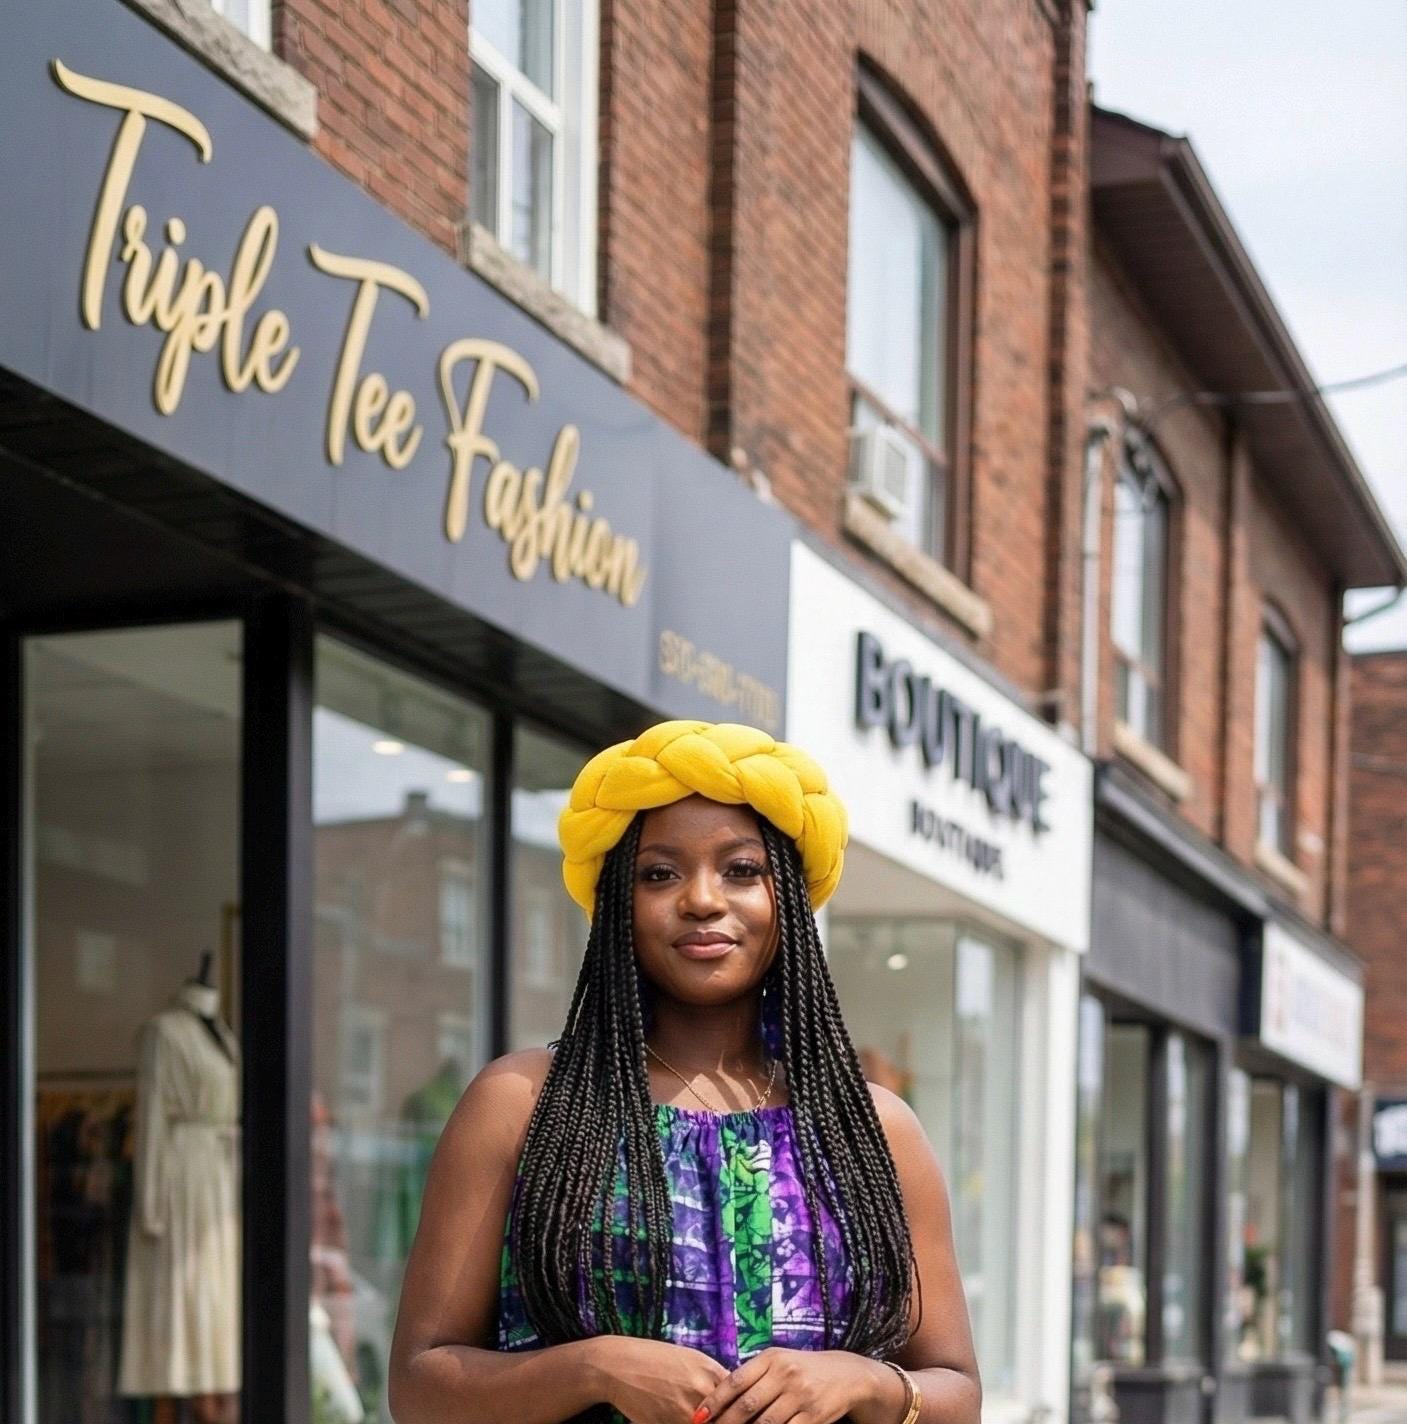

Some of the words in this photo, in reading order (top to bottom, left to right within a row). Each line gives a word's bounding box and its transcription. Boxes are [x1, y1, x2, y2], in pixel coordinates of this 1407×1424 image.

[52, 57, 300, 415] Triple
[308, 241, 430, 468] Tee
[438, 337, 647, 606] Fashion
[856, 631, 1051, 836] BOUTIQUE
